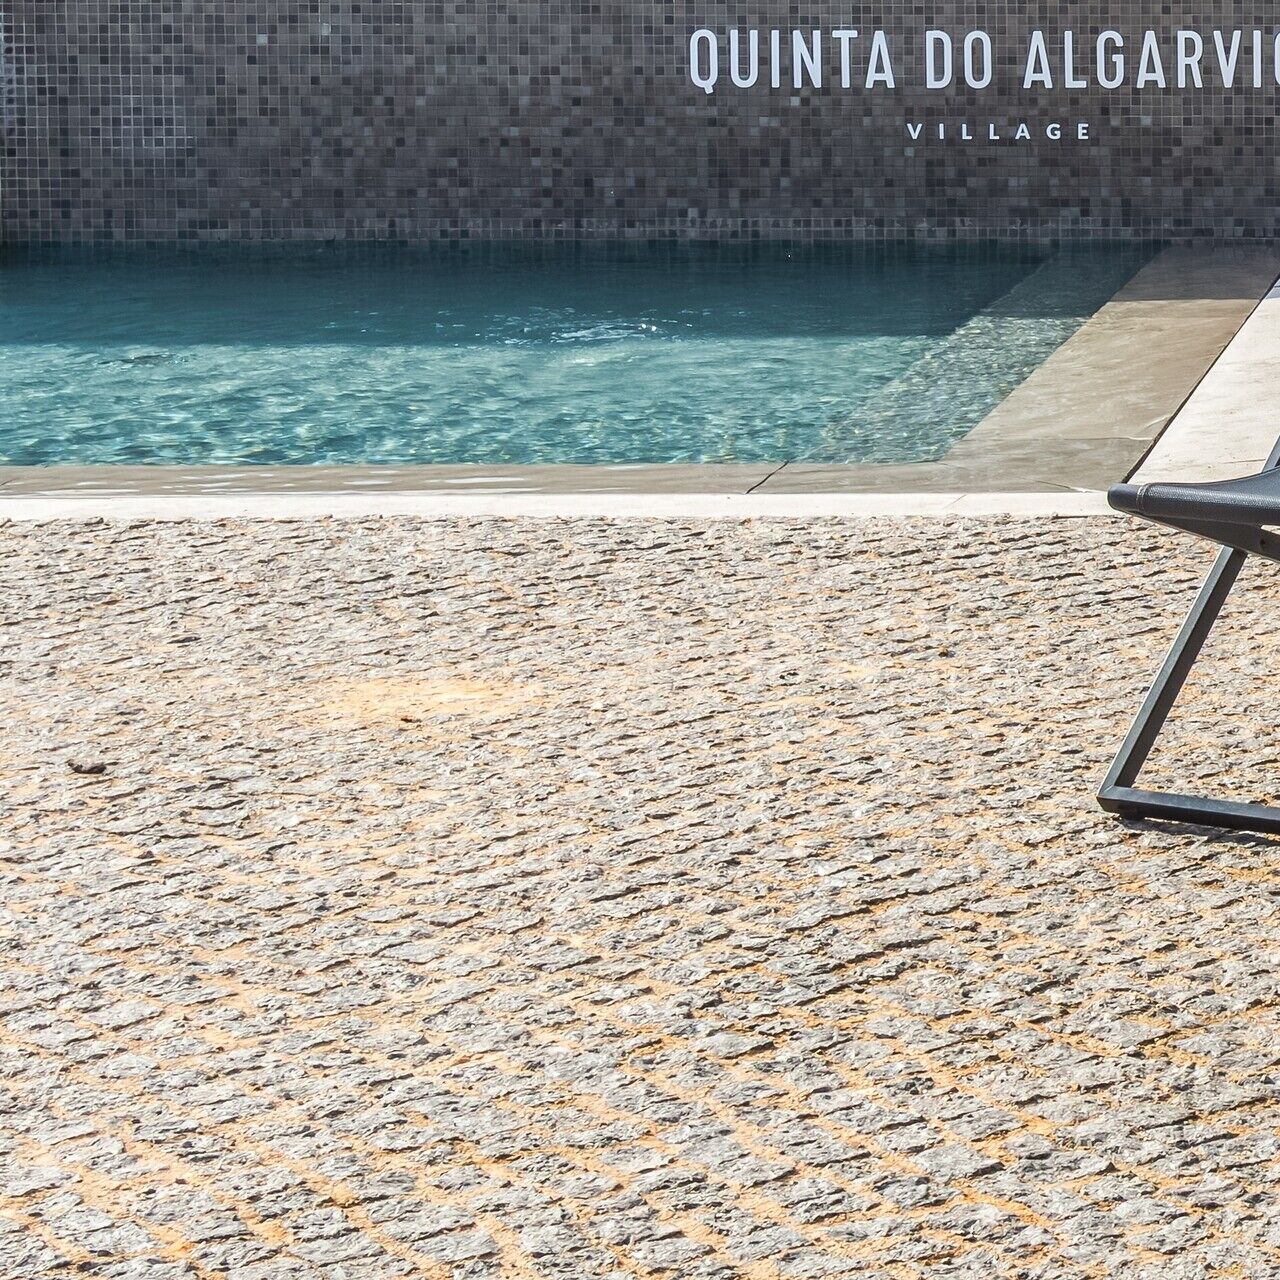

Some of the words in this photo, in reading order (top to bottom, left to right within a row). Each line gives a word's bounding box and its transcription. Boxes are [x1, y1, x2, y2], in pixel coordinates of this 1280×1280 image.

[689, 29, 896, 95] QUINTA
[925, 30, 992, 89] DO
[906, 123, 1090, 140] VILLAGE
